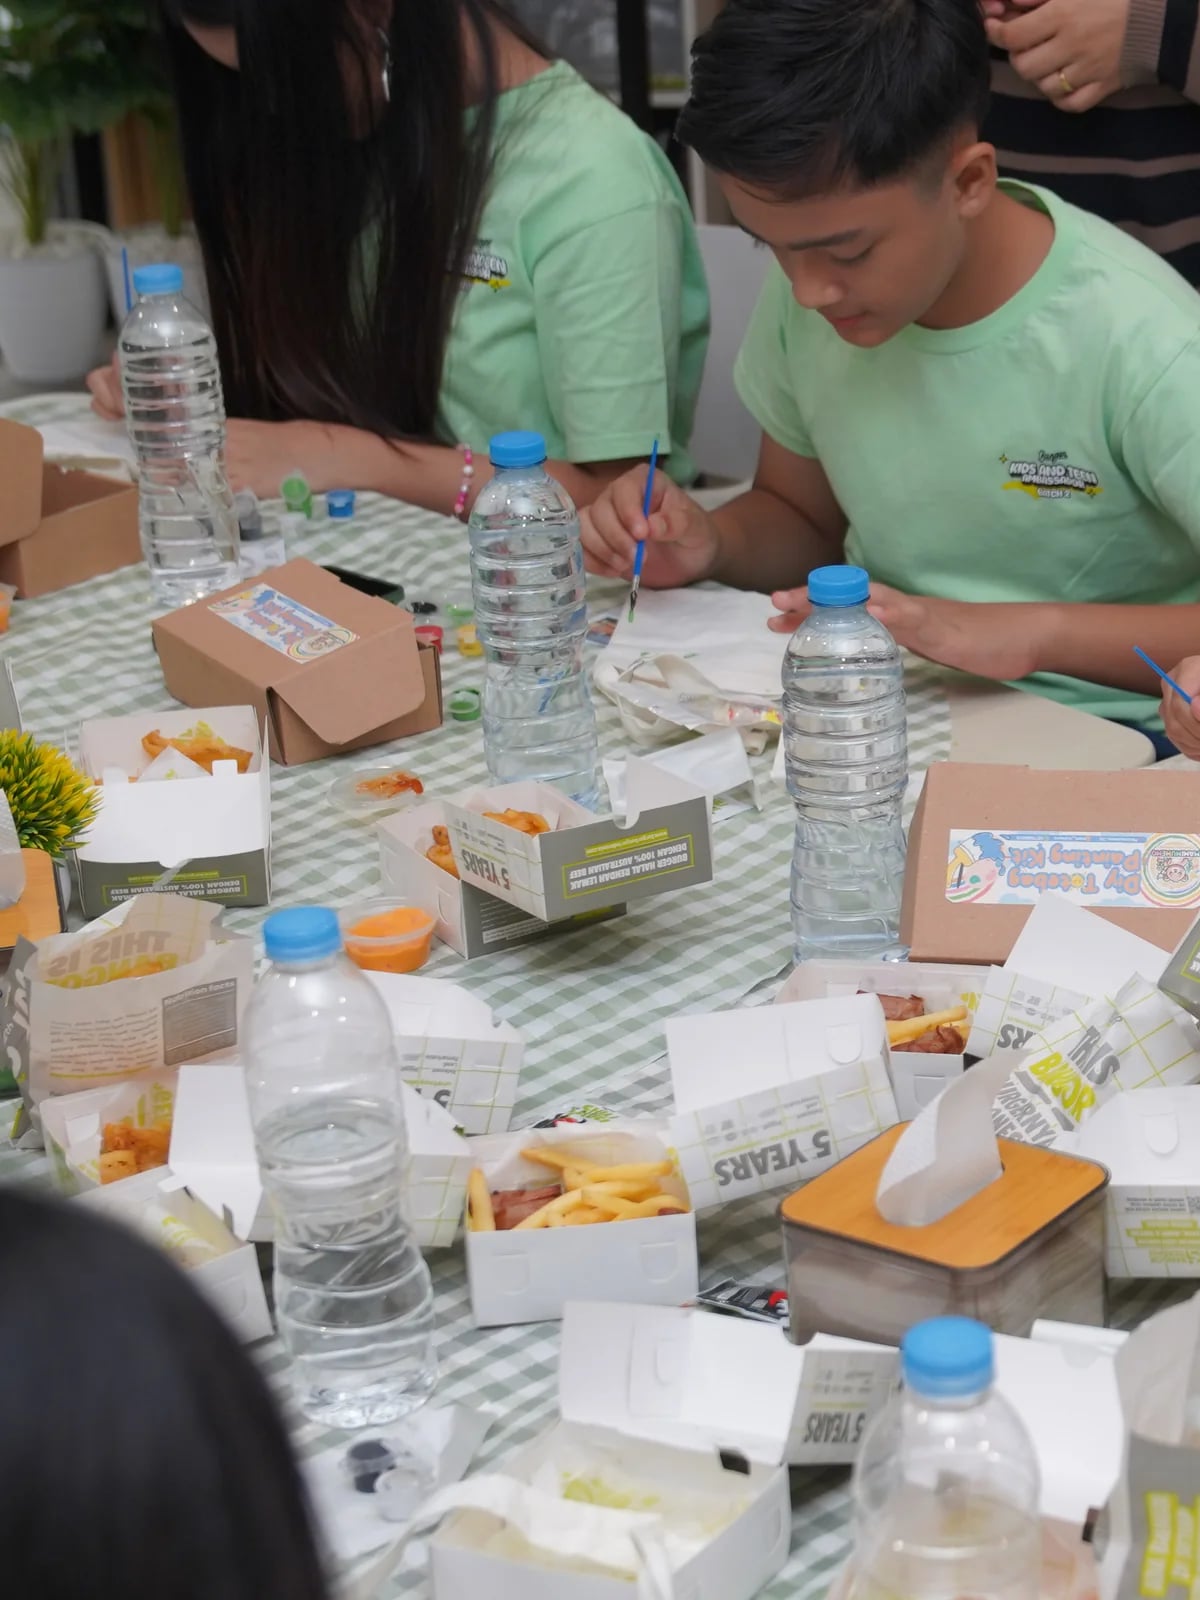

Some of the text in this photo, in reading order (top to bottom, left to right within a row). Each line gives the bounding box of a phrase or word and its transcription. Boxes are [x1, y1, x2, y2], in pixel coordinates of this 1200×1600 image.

[1010, 462, 1098, 485] KIDS AND TEEN
[1064, 489, 1072, 499] 2
[634, 851, 655, 863] 100%
[657, 842, 687, 857] DENGAN
[1007, 843, 1141, 873] Painting Kit
[462, 848, 511, 891] 5 YEARS
[569, 865, 591, 880] BEEF
[570, 853, 688, 890] BURGER HALAL RENDAH LEMAK
[588, 856, 633, 875] AUSTRALIAN
[206, 886, 241, 895] BURGER
[207, 880, 241, 888] DENGAN
[1007, 871, 1141, 895] Diy Totebag
[714, 1128, 833, 1187] 5 YEARS
[804, 1412, 867, 1443] 5 YEARS
